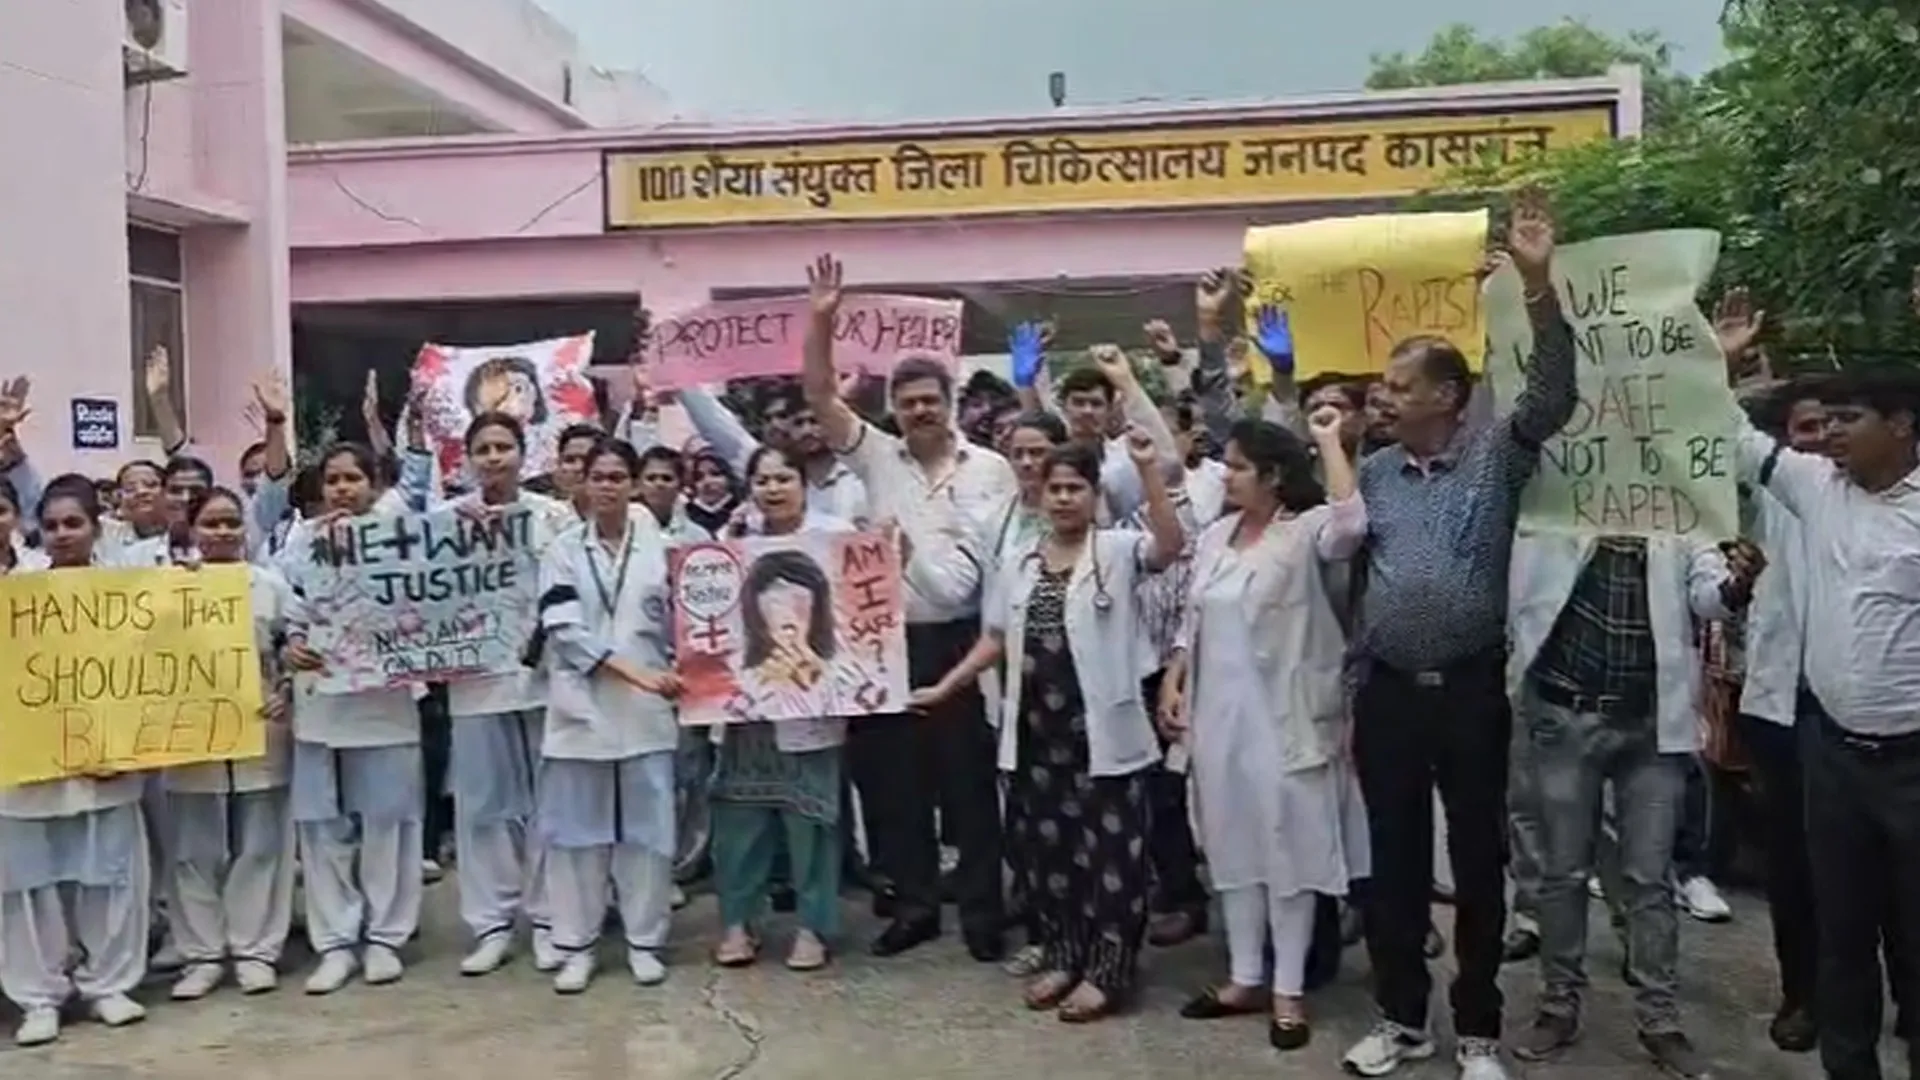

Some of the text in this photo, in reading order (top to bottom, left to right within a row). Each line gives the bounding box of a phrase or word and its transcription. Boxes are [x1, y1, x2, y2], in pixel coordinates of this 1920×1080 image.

[772, 150, 881, 207] संयुक्त
[890, 144, 985, 191] जिला
[1001, 137, 1230, 187] चिकित्सालय
[1243, 134, 1371, 176] जनपद
[1567, 265, 1628, 319] WE
[651, 312, 795, 363] PROTECT
[832, 310, 868, 347] UR
[1621, 321, 1654, 357] TO
[1661, 317, 1695, 355] BE
[1537, 436, 1608, 477] NOT
[1686, 437, 1728, 479] BE
[1573, 480, 1700, 535] RAPED
[370, 561, 518, 606] JUSTICE
[843, 544, 885, 575] AM
[10, 587, 243, 639] HANDS THAT
[853, 575, 888, 611] I
[53, 697, 243, 771] BLEED
